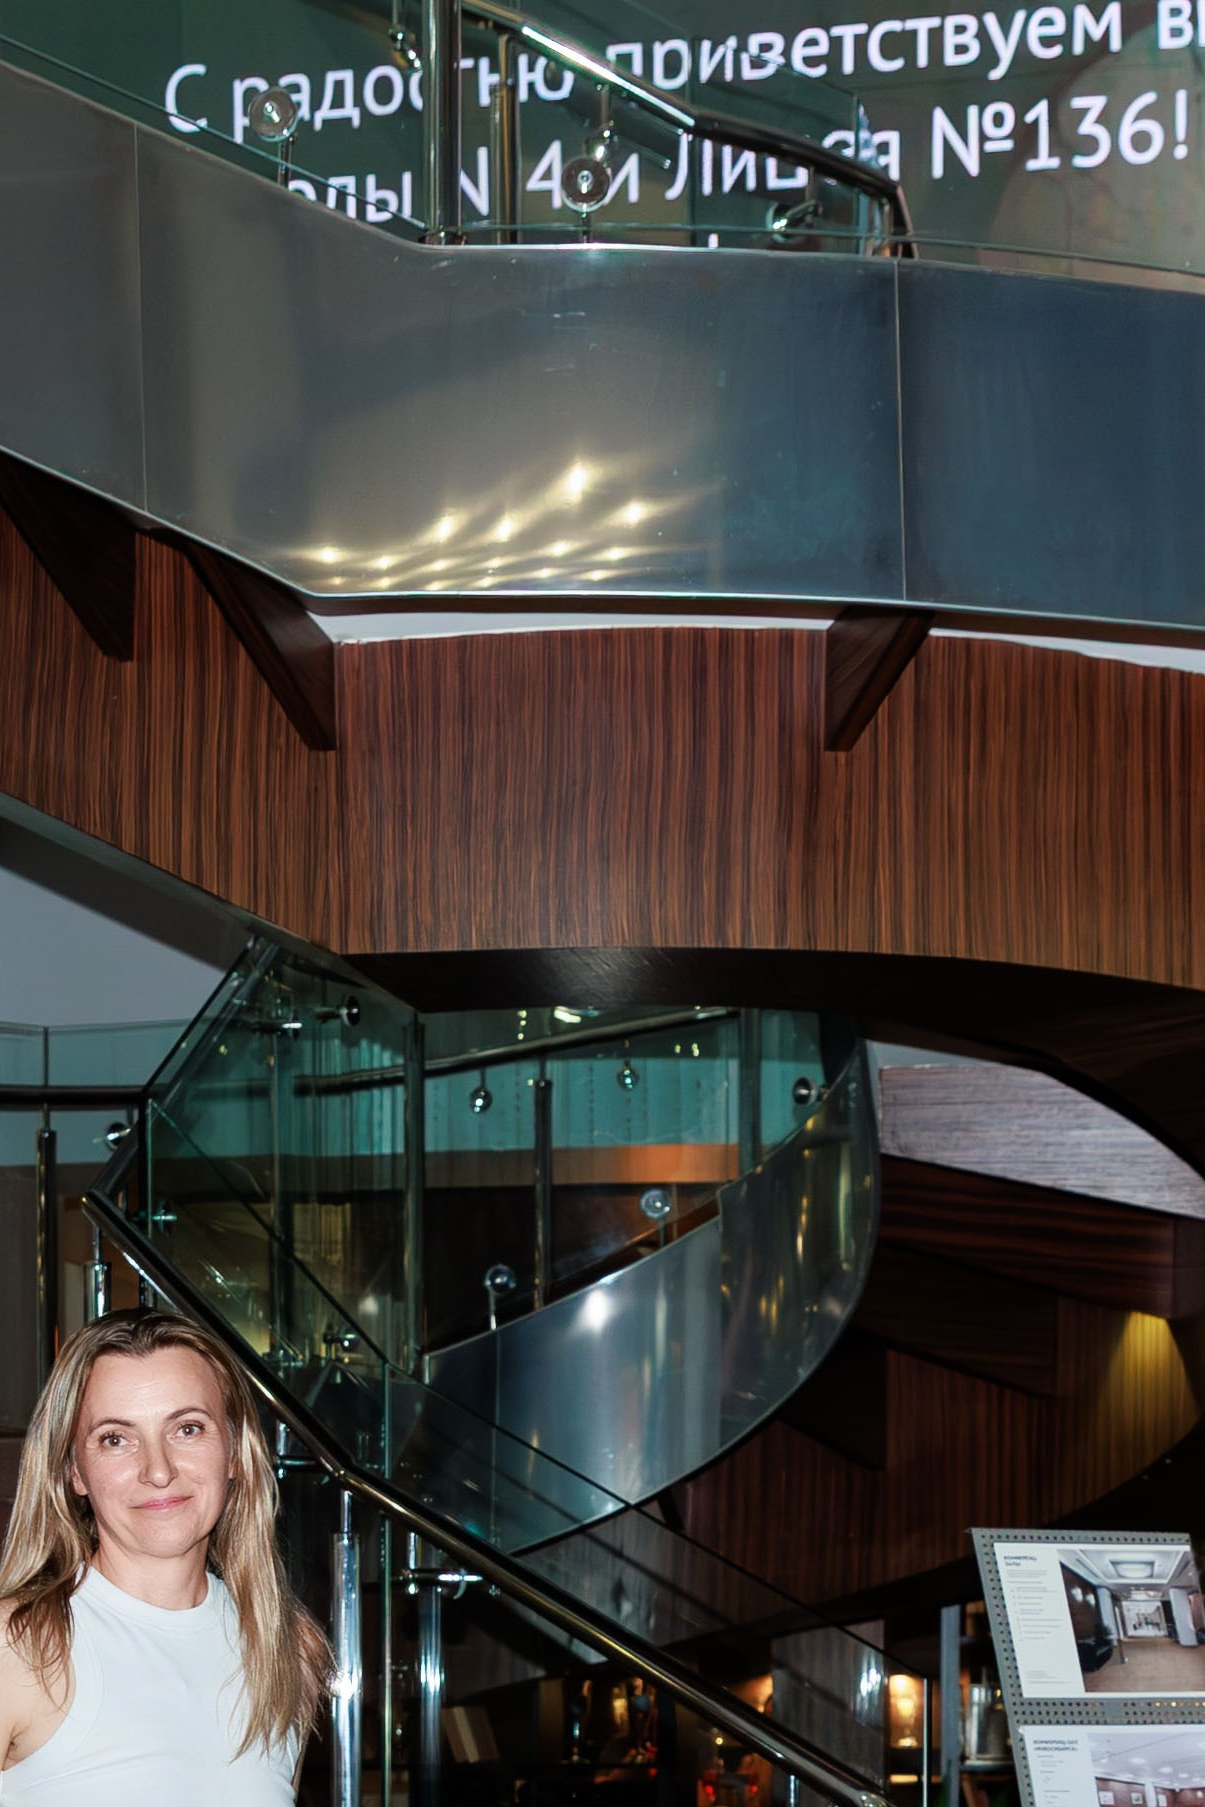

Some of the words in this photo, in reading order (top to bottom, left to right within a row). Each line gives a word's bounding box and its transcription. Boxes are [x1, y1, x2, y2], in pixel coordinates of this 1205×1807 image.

[165, 63, 208, 133] С
[606, 1, 1122, 90] приветствуем
[931, 89, 1189, 180] №136!
